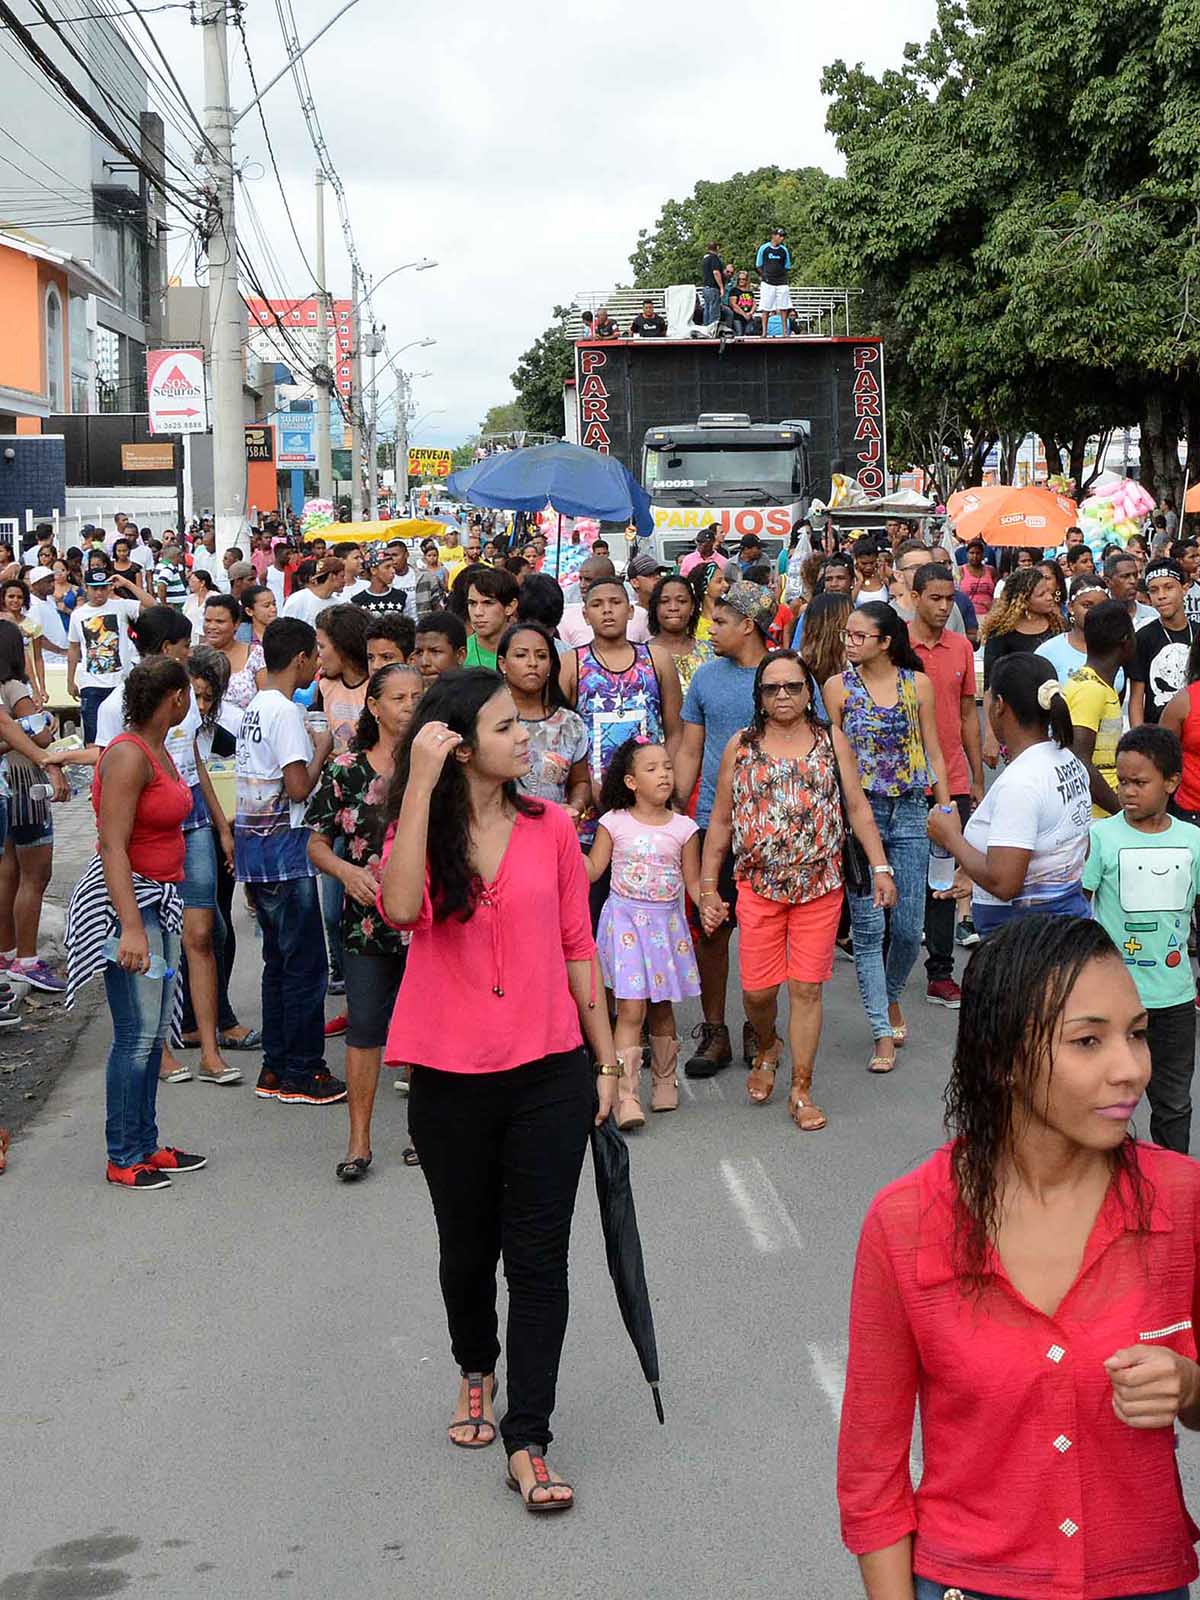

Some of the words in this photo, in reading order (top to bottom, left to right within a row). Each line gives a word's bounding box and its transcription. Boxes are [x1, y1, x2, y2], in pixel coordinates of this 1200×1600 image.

[166, 379, 189, 389] SOS
[246, 445, 269, 457] ISBAL
[409, 448, 450, 460] CERVEJA
[410, 460, 422, 475] 2
[437, 460, 449, 477] 5
[1056, 776, 1087, 805] TAMEN
